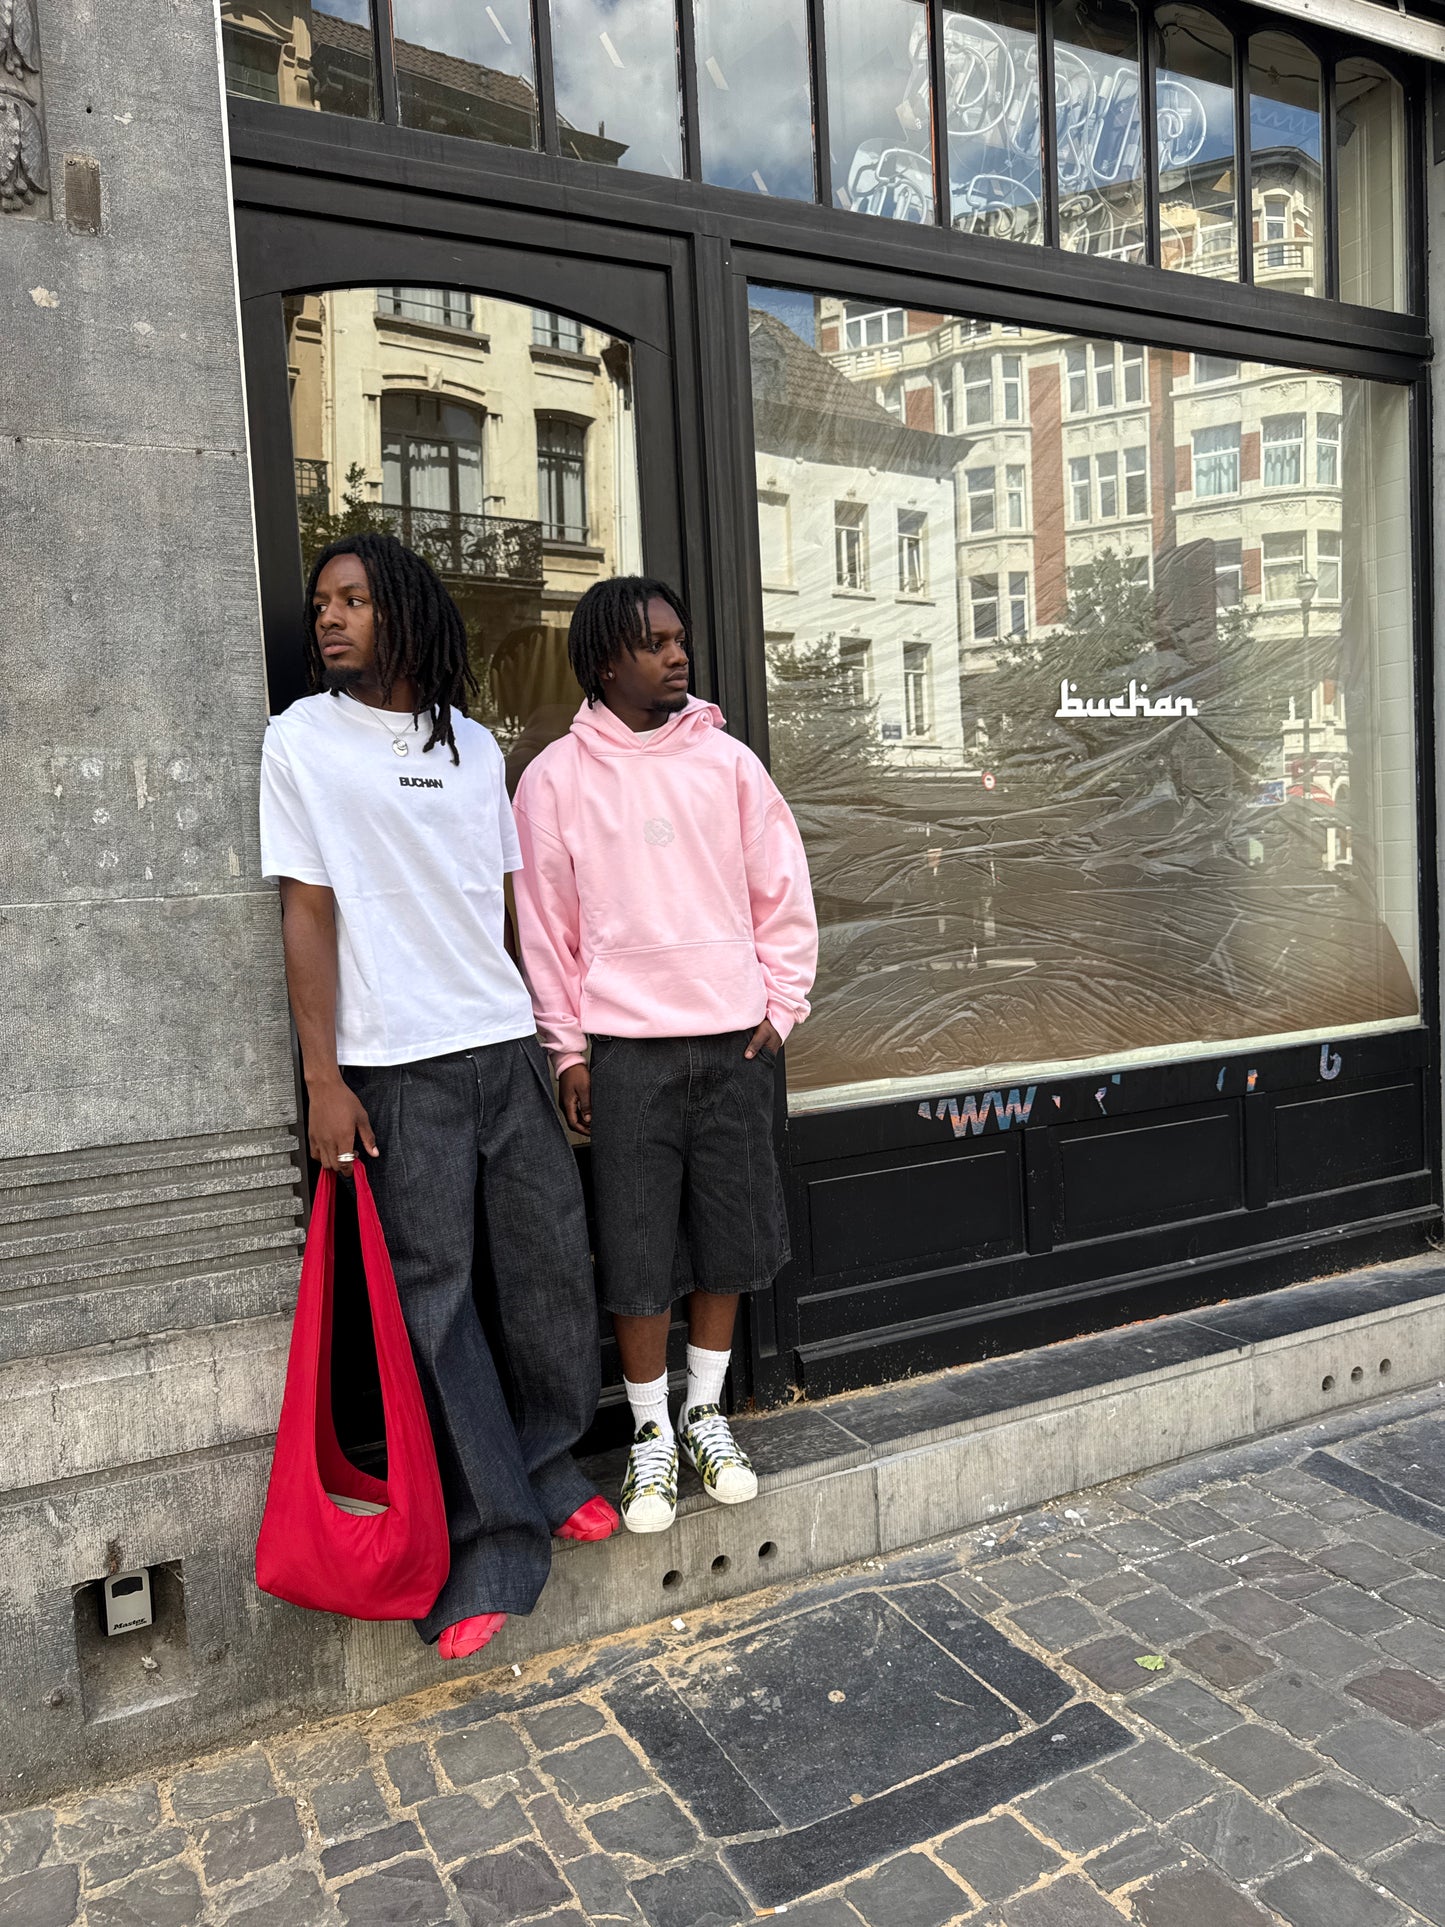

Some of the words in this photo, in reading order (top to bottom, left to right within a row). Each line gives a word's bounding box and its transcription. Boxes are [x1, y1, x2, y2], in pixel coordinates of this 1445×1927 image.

[1055, 678, 1199, 718] buchan
[399, 776, 443, 788] BUCHAN
[113, 1617, 146, 1630] Master
